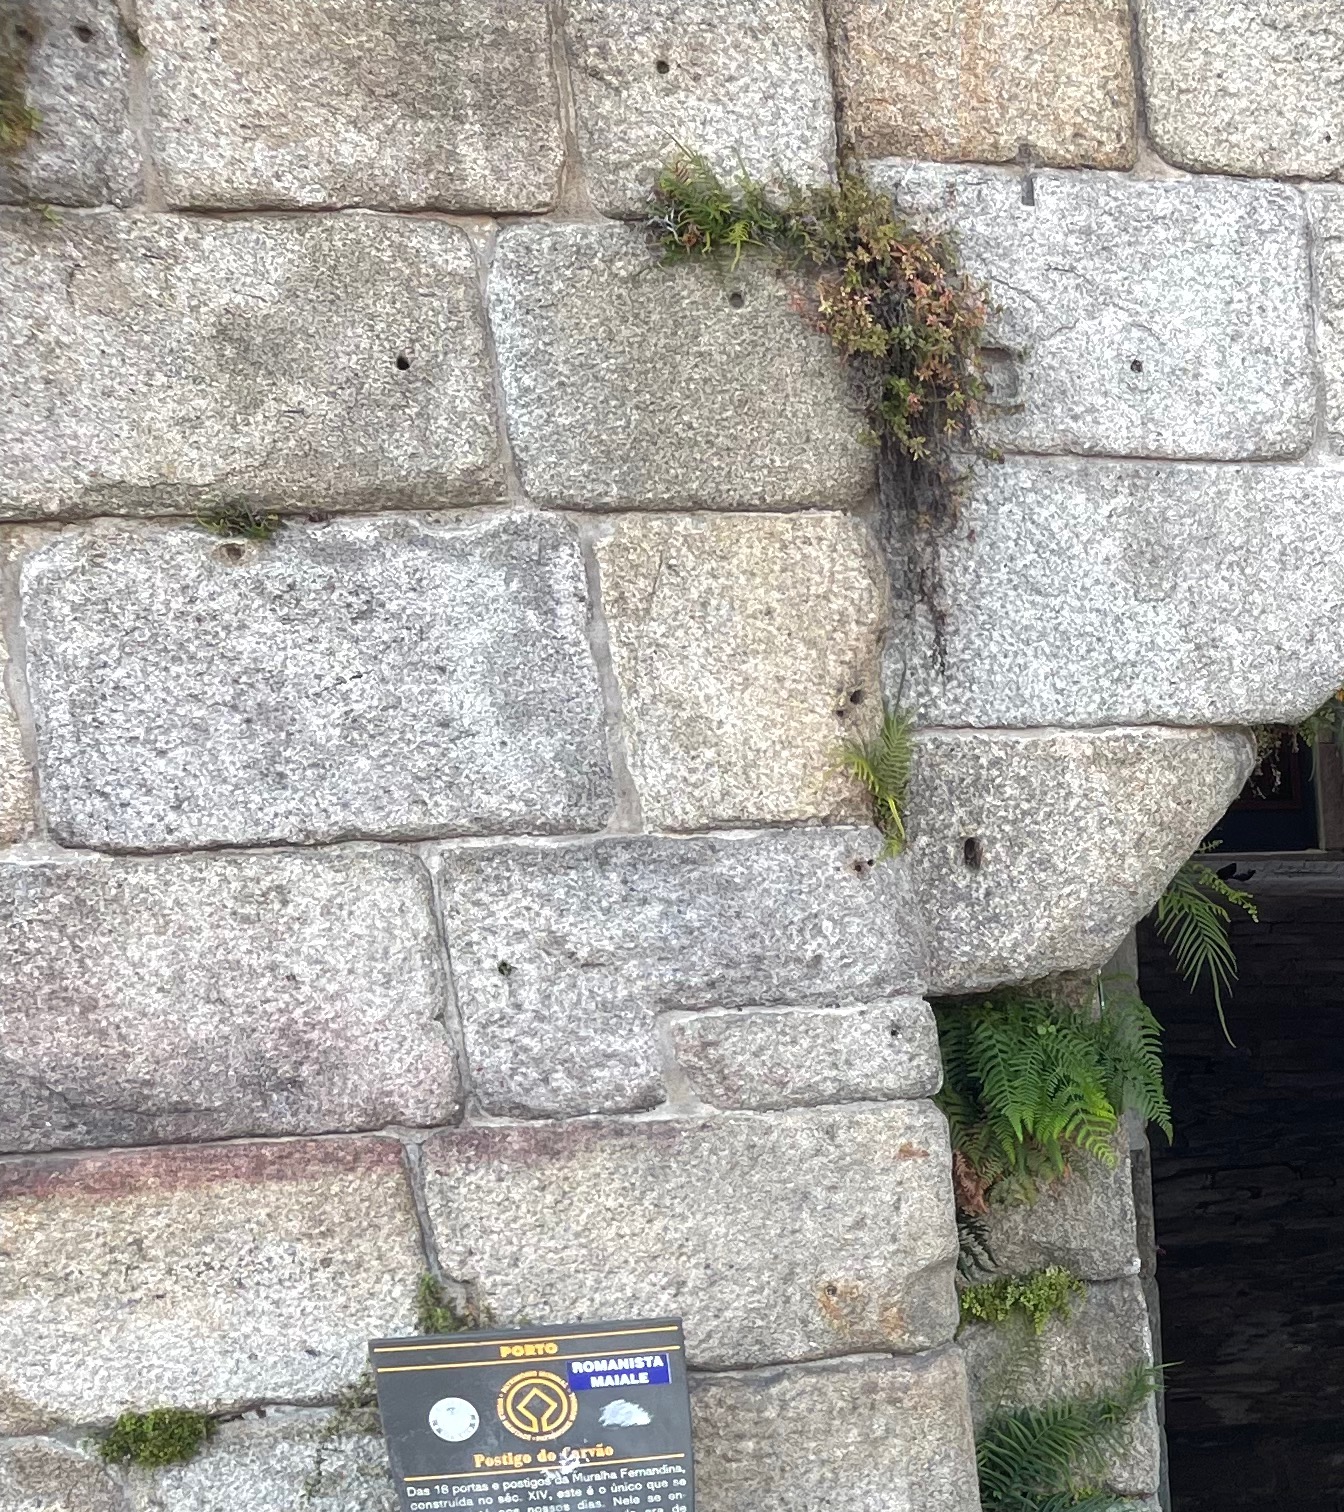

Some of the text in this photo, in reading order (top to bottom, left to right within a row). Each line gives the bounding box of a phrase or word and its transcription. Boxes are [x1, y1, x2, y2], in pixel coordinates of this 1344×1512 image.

[500, 1342, 559, 1358] PORTO
[572, 1356, 664, 1373] ROMANISTA
[590, 1372, 649, 1388] MAIALE
[474, 1452, 532, 1468] Postigo
[537, 1449, 557, 1462] do
[407, 1487, 430, 1497] Das
[452, 1482, 489, 1496] portas
[492, 1482, 499, 1490] e
[503, 1477, 551, 1491] postigos
[555, 1475, 569, 1485] da
[573, 1470, 617, 1482] Muralha
[620, 1464, 686, 1479] Fernandina,
[410, 1497, 473, 1511] construída
[478, 1496, 494, 1505] no
[498, 1493, 523, 1503] séc.
[557, 1488, 582, 1498] este
[586, 1486, 594, 1495] é
[599, 1486, 606, 1494] o
[611, 1482, 642, 1493] único
[647, 1480, 668, 1491] que
[673, 1478, 686, 1487] se
[578, 1500, 606, 1510] dias.
[613, 1495, 640, 1506] Nele
[647, 1494, 662, 1503] se
